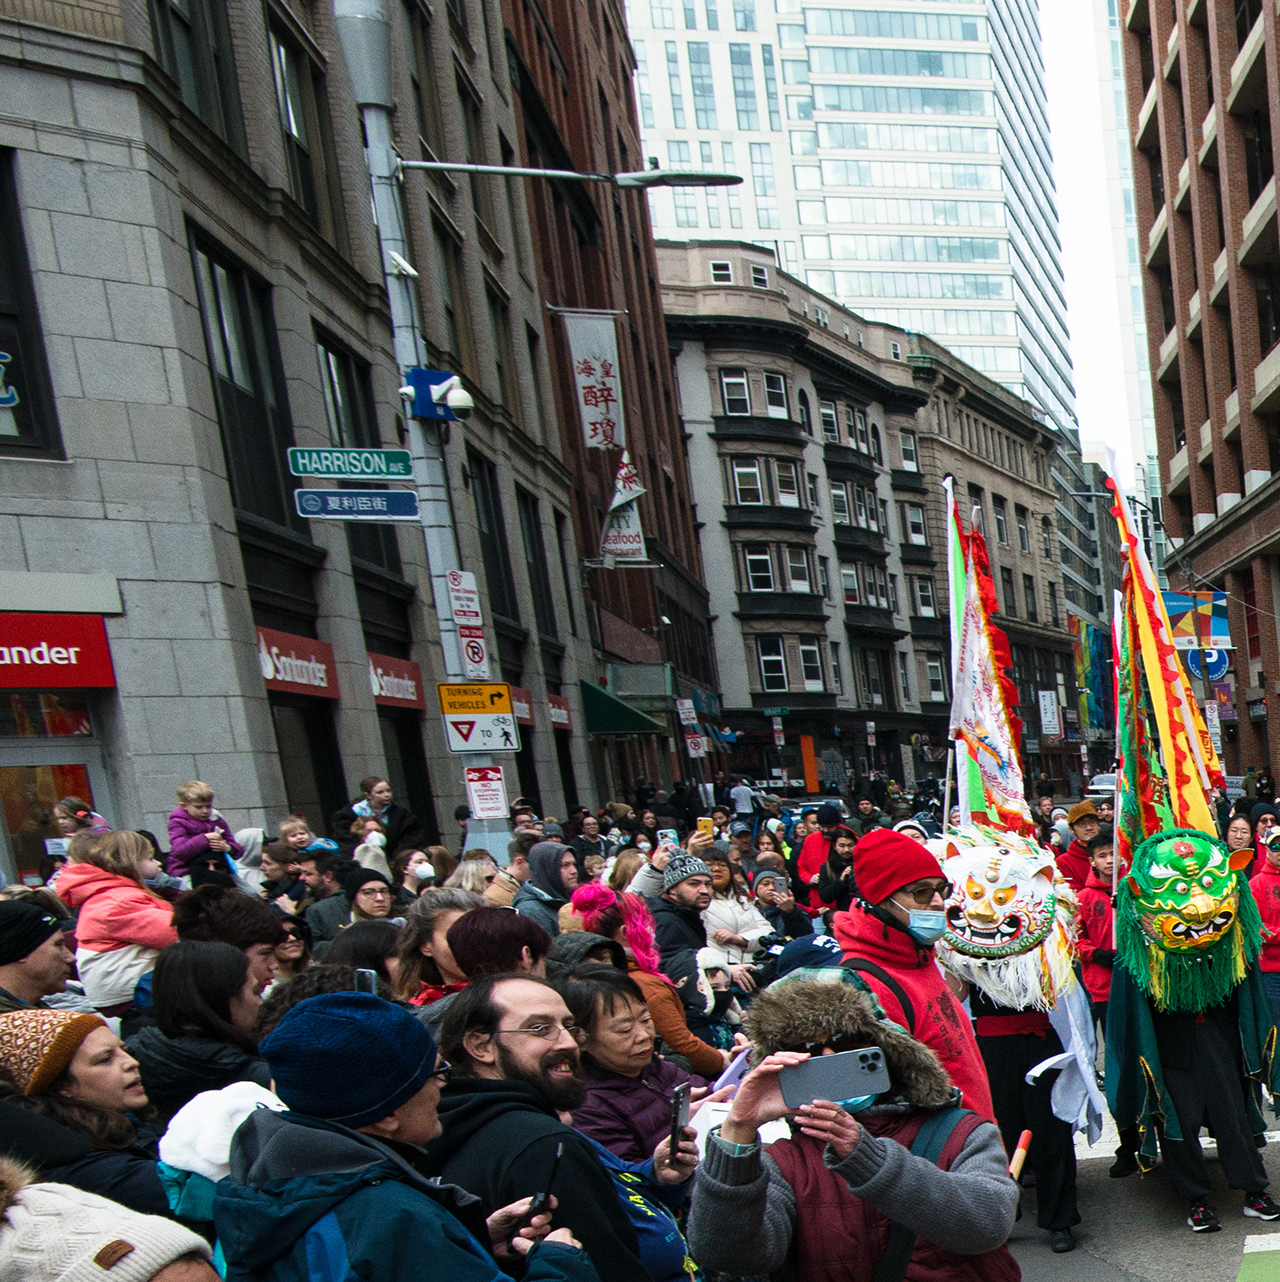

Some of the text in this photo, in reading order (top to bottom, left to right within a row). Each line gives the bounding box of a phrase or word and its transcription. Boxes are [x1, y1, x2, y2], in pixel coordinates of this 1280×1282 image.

[296, 452, 406, 473] HARRISON AVE
[446, 687, 484, 697] TURNING
[447, 701, 487, 710] VEHICLES
[480, 729, 493, 738] TO
